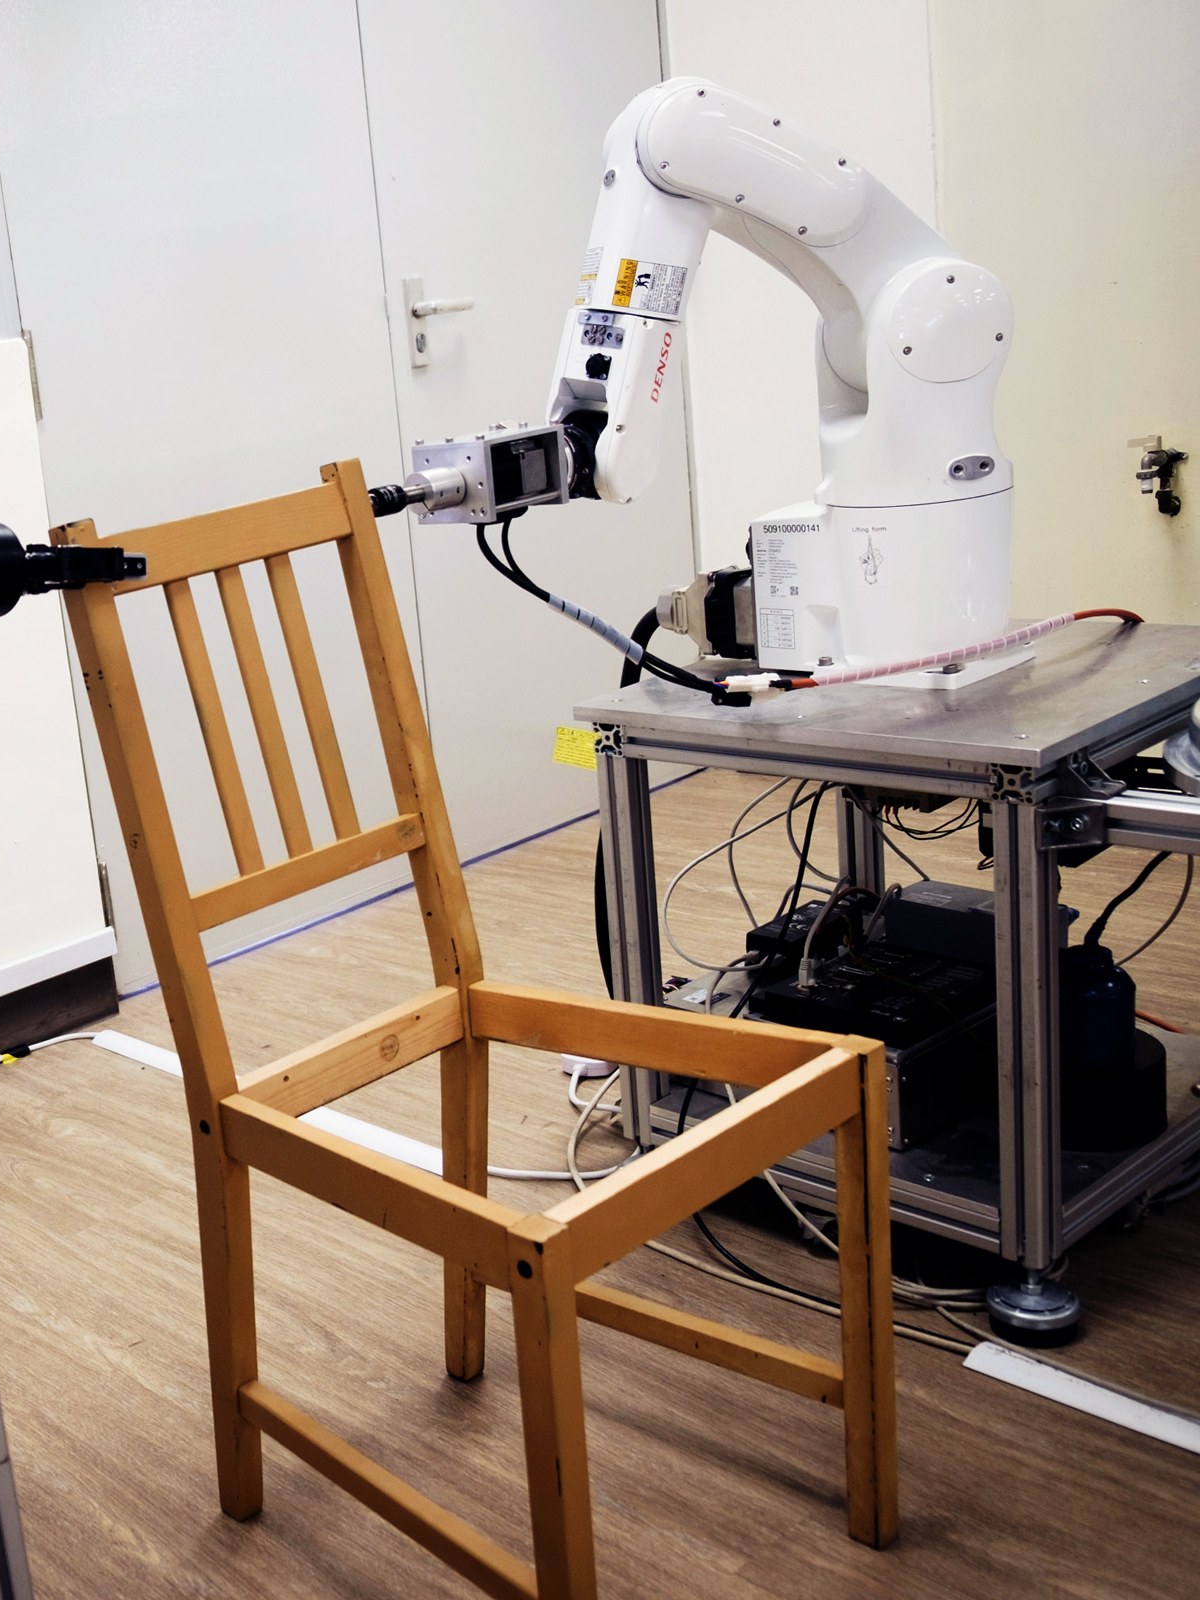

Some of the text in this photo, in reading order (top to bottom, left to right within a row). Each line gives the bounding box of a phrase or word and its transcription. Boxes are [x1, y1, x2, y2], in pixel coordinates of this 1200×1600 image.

[620, 260, 634, 297] WARNING
[651, 332, 673, 404] DENSO
[763, 524, 820, 534] 509100000141
[851, 526, 869, 534] Lifting
